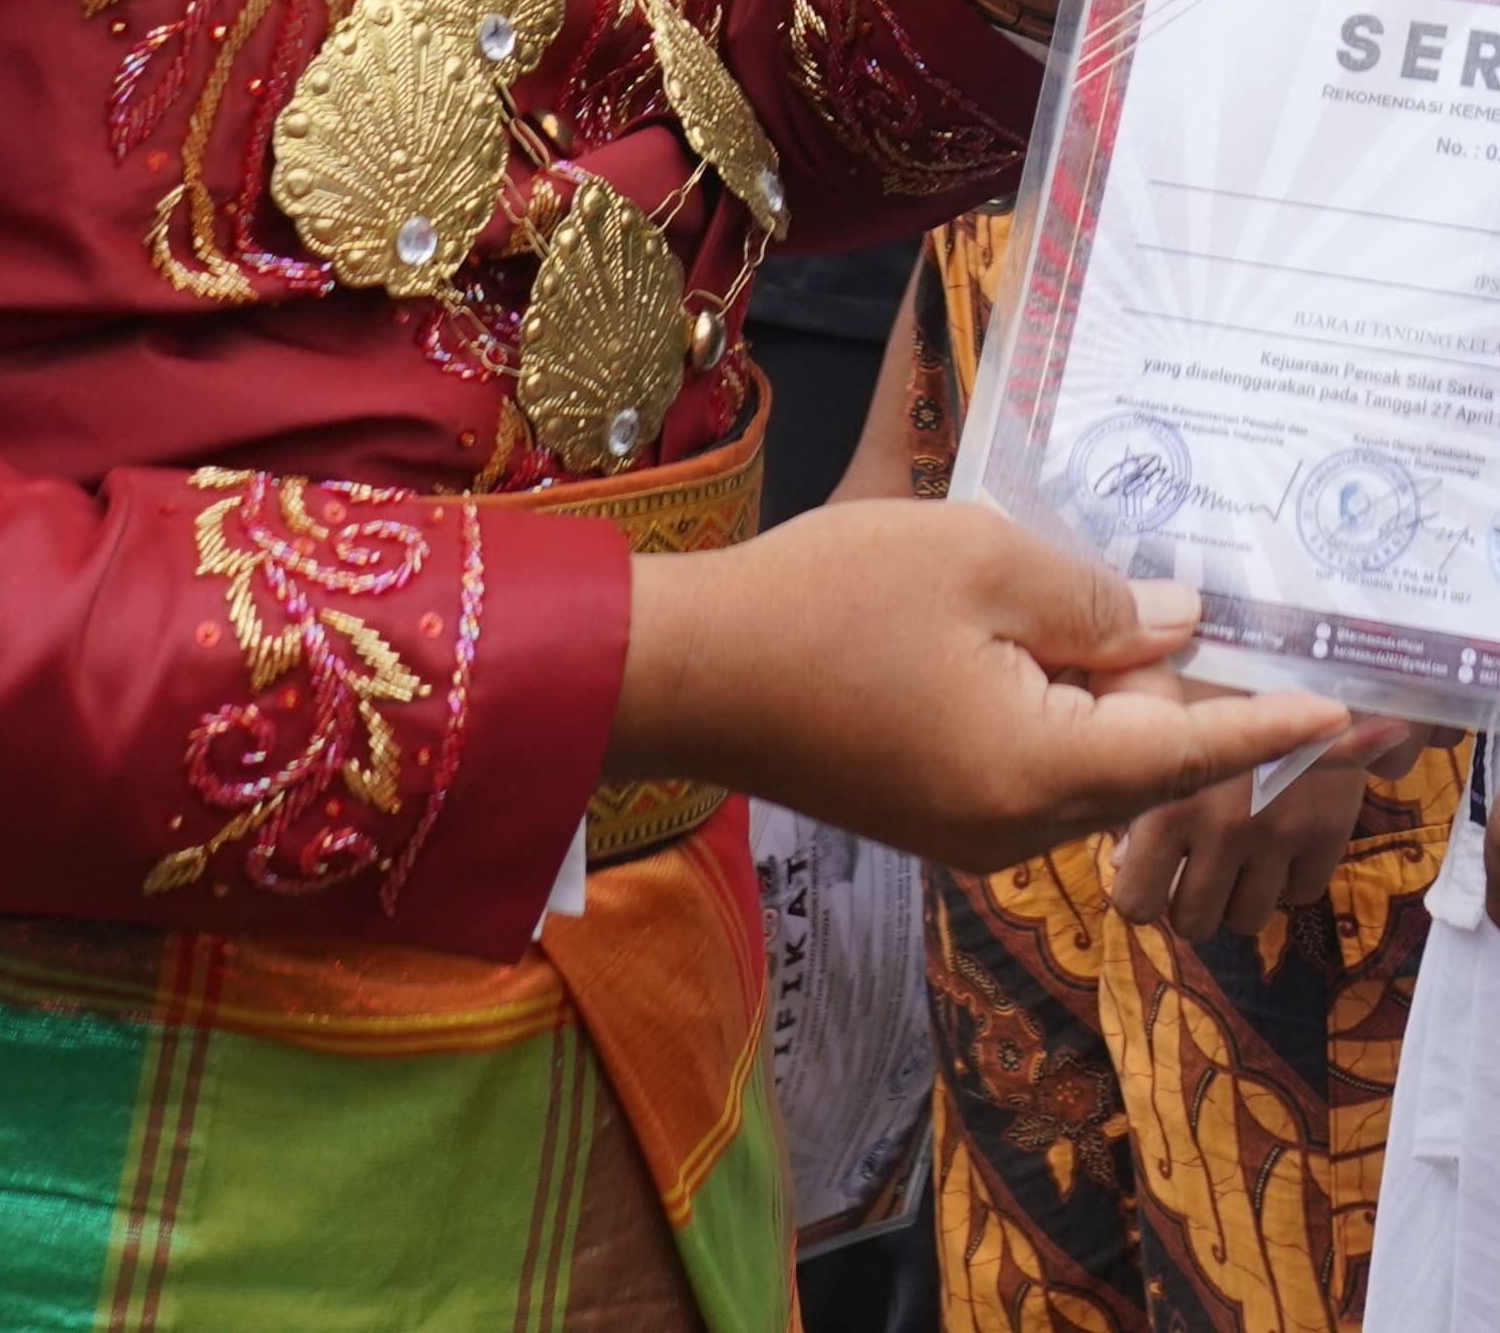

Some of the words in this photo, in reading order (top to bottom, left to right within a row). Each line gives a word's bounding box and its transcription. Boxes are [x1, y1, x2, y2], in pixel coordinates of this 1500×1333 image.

[1436, 135, 1469, 156] No.
[1292, 309, 1351, 334] JUARA
[1369, 321, 1453, 350] TANDING
[1142, 356, 1183, 378] yang
[1184, 361, 1318, 401] diselenggarakan
[1319, 383, 1360, 407] pada
[1363, 389, 1428, 418] Tanggal
[1432, 402, 1452, 419] 27
[1455, 406, 1494, 429] April
[1259, 349, 1341, 381] Kejuaraan
[1343, 362, 1402, 386] Pencak
[1406, 372, 1444, 393] Silat
[1446, 379, 1493, 401] Satria
